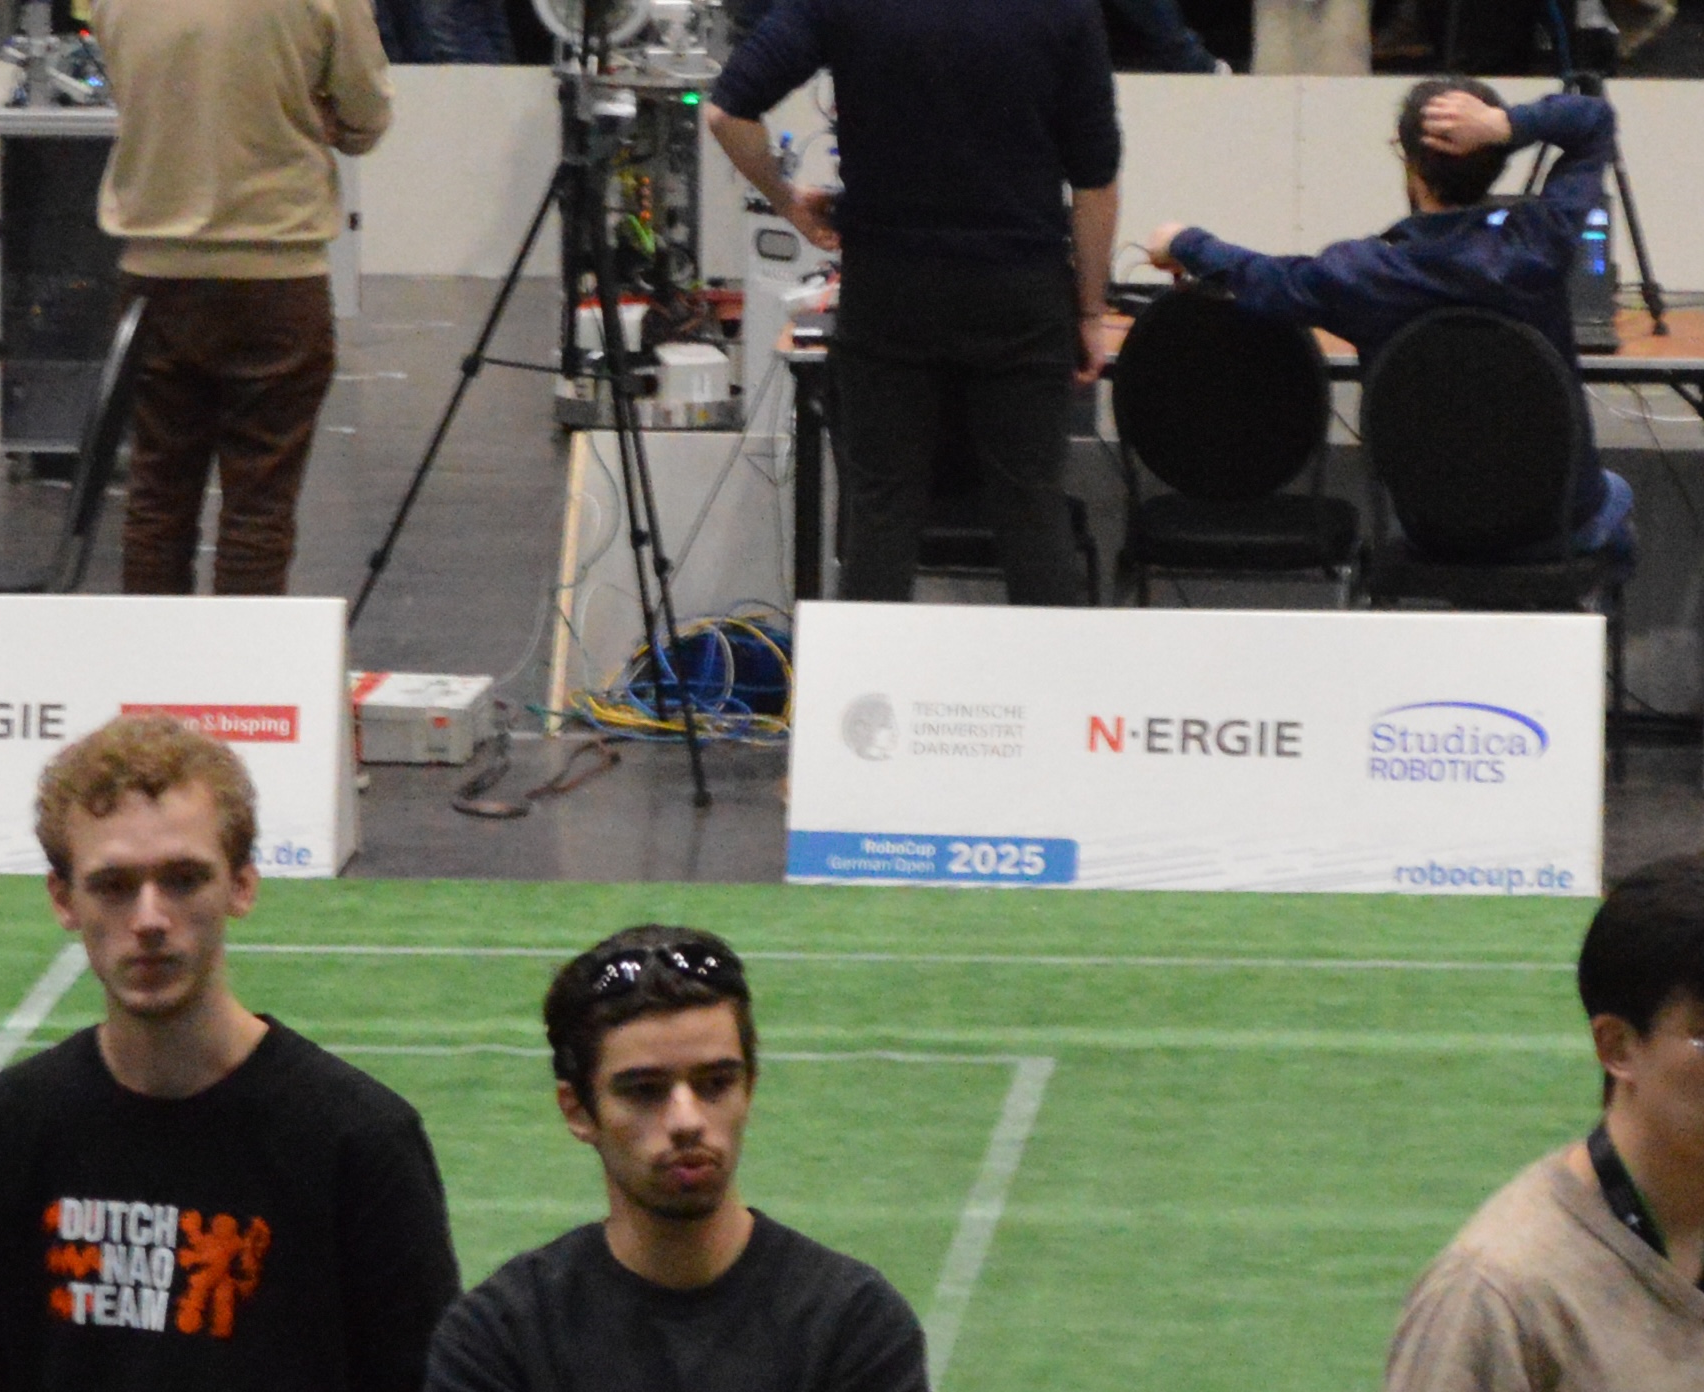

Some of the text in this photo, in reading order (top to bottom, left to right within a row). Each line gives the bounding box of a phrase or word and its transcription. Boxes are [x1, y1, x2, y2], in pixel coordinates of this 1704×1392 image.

[913, 701, 1026, 720] TECHNISCHE
[221, 717, 291, 737] bisping
[1370, 721, 1529, 758] Studica
[912, 740, 1024, 760] DARMSTADT
[1369, 755, 1505, 784] ROBOTICS
[862, 839, 936, 859] RoboCup
[947, 844, 1045, 876] 2025
[1394, 861, 1574, 895] robocup.de
[58, 1197, 178, 1249] DUTCH
[100, 1242, 175, 1290] NAO
[68, 1281, 169, 1332] TEAM
